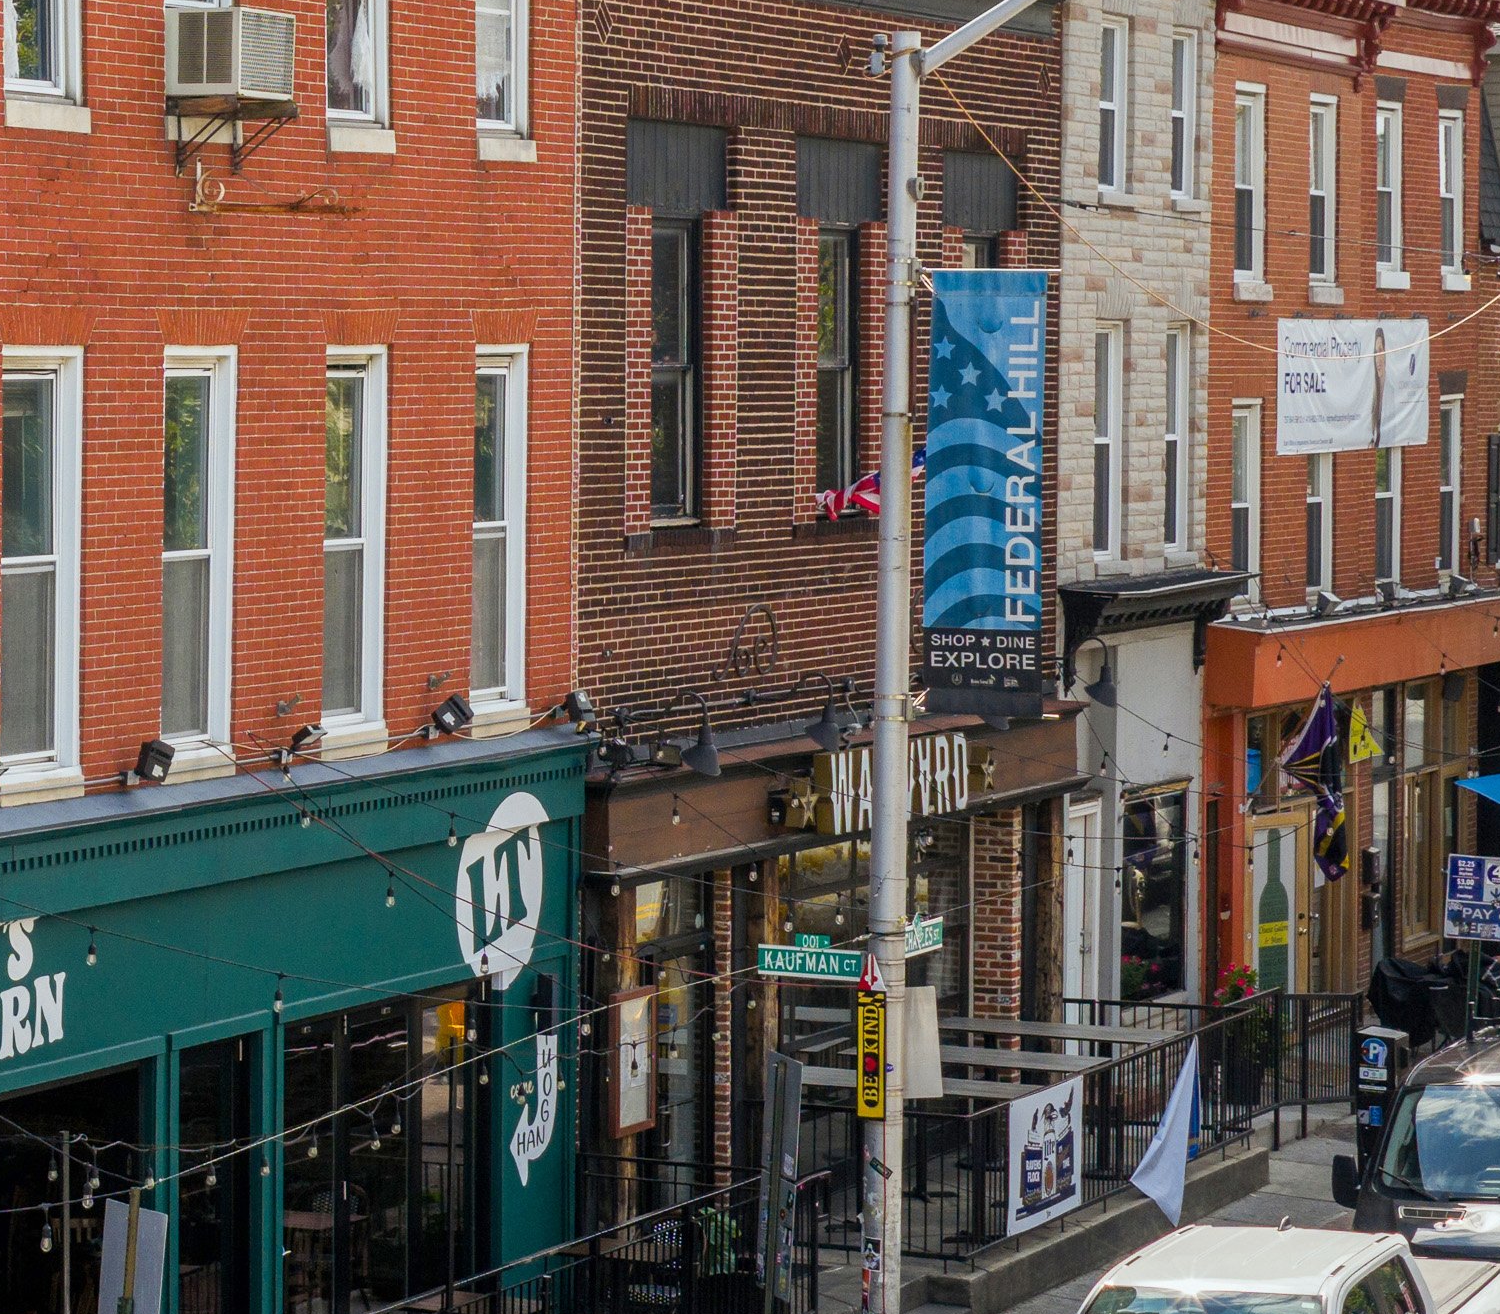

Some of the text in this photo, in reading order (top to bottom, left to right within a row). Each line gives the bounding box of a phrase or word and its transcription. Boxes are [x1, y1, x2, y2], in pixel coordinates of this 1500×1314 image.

[1284, 372, 1326, 394] FOR SALE
[1005, 300, 1040, 623] FEDERAL HILL
[931, 634, 1036, 649] SHOP DINE
[930, 651, 1036, 670] EXPLORE
[1456, 878, 1475, 886] $3.00
[1462, 907, 1494, 920] PAY
[764, 949, 859, 974] KAUFMAN CT.
[863, 1005, 879, 1102] BE KIND
[1025, 1160, 1042, 1171] RAVENS
[1027, 1172, 1041, 1183] FLOCK
